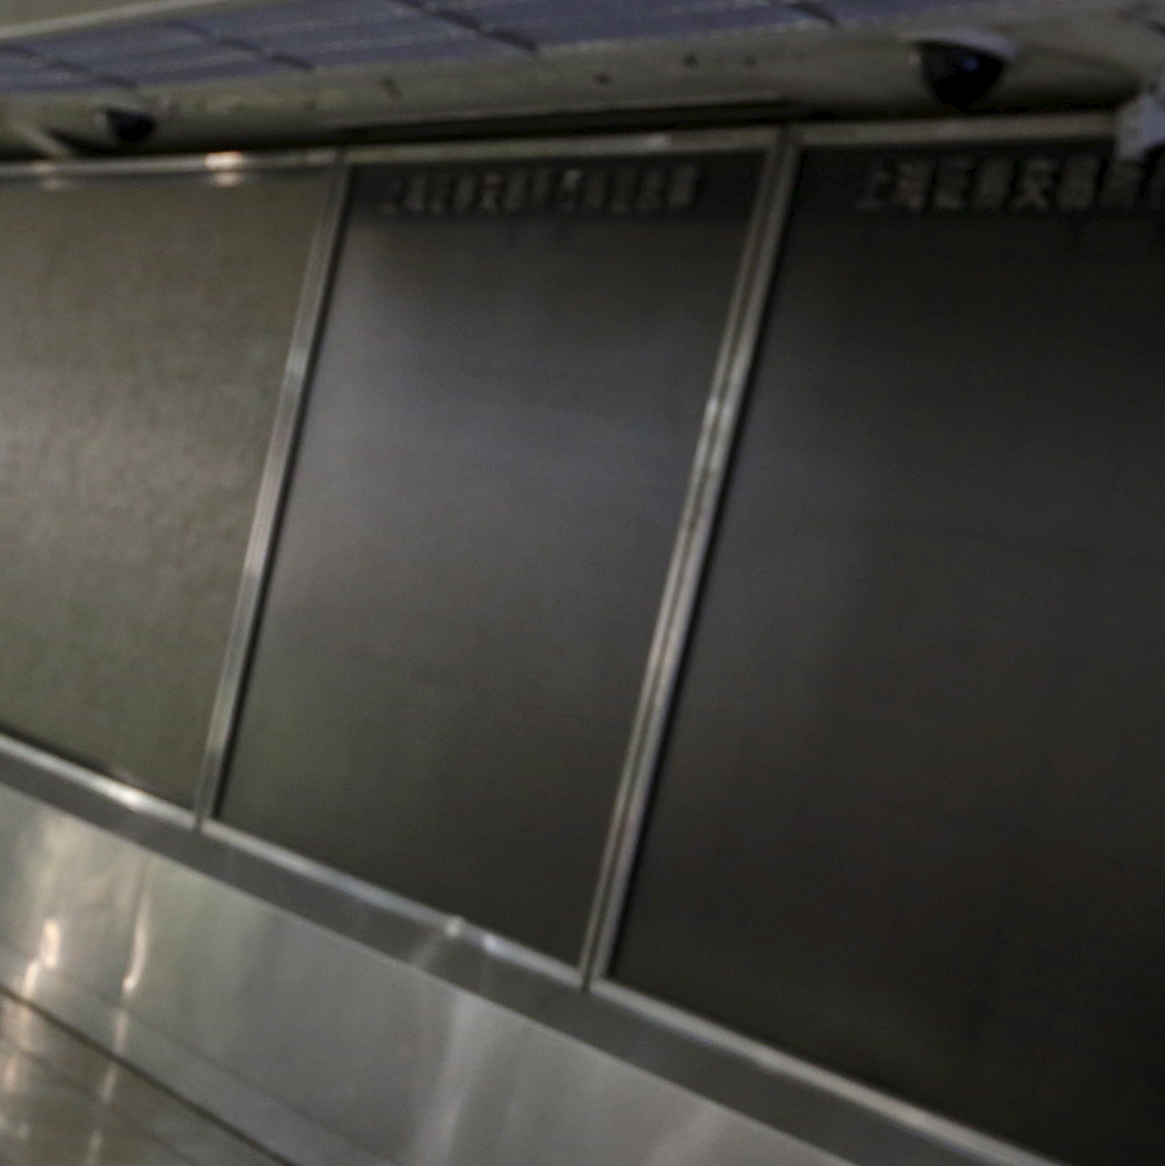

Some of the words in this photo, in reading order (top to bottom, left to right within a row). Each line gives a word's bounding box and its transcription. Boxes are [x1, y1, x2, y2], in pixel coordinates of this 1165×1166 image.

[855, 154, 1165, 213] 上海证券交易所
